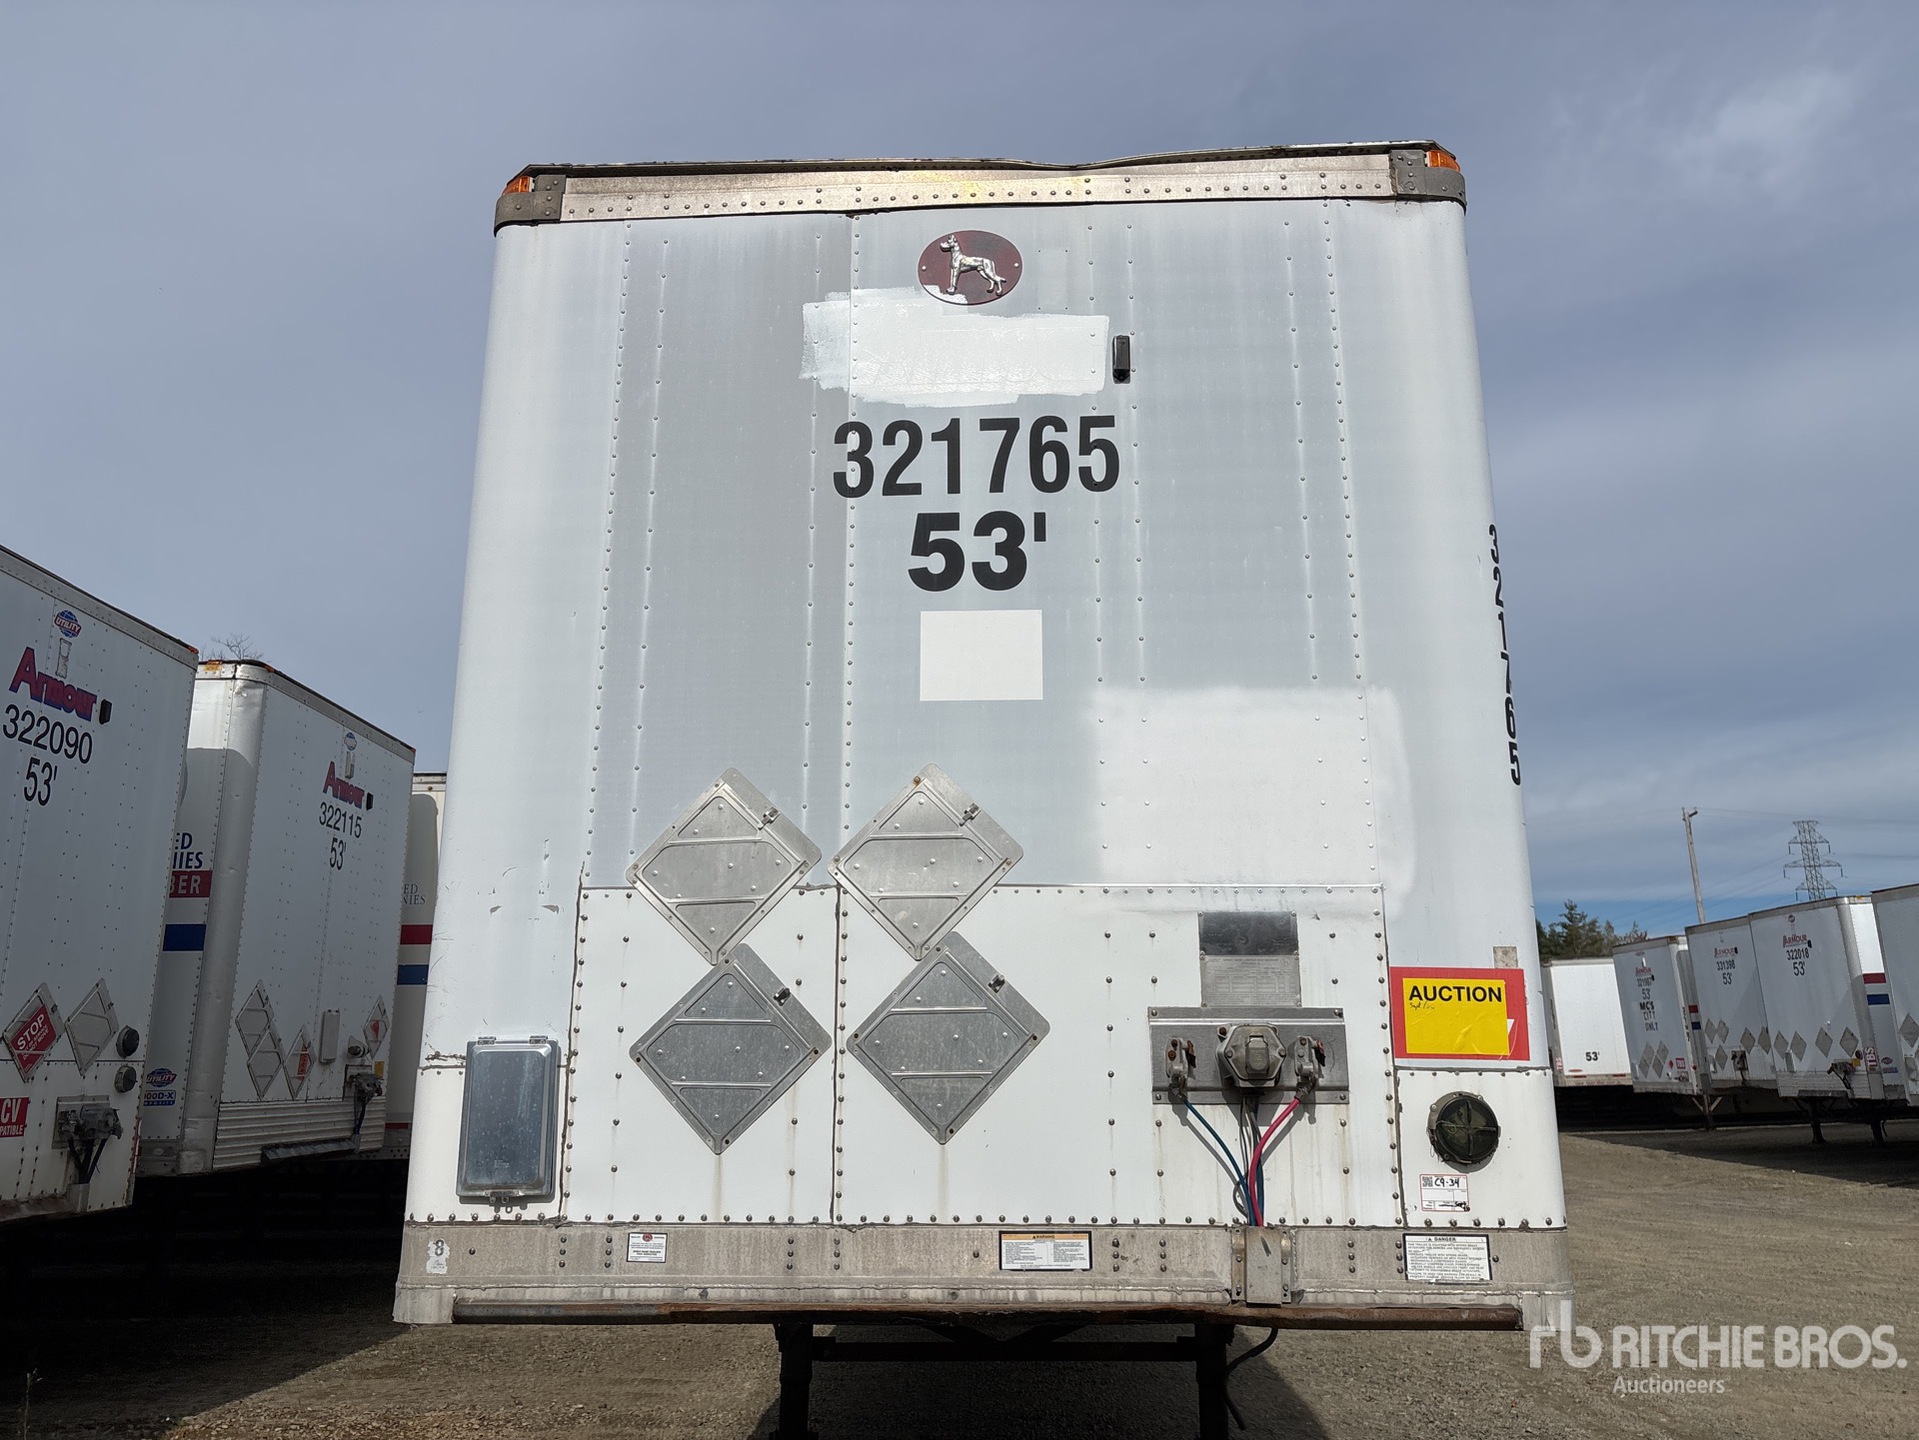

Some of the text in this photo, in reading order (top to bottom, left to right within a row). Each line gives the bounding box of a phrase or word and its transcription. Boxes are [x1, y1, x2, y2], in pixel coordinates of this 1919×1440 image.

[832, 415, 1120, 499] 321765
[907, 510, 1047, 592] 53'
[55, 615, 81, 634] UTILITY
[1488, 523, 1522, 787] 321765
[2, 703, 93, 765] 322090
[23, 756, 59, 807] 53'
[318, 801, 362, 839] 322115
[329, 836, 347, 871] 53'
[1785, 948, 1810, 961] 322018
[1792, 961, 1806, 977] 53'
[1408, 985, 1502, 1002] AUCTION
[1722, 972, 1733, 985] 53'
[16, 1013, 45, 1051] STOP
[1585, 1051, 1600, 1062] 53'
